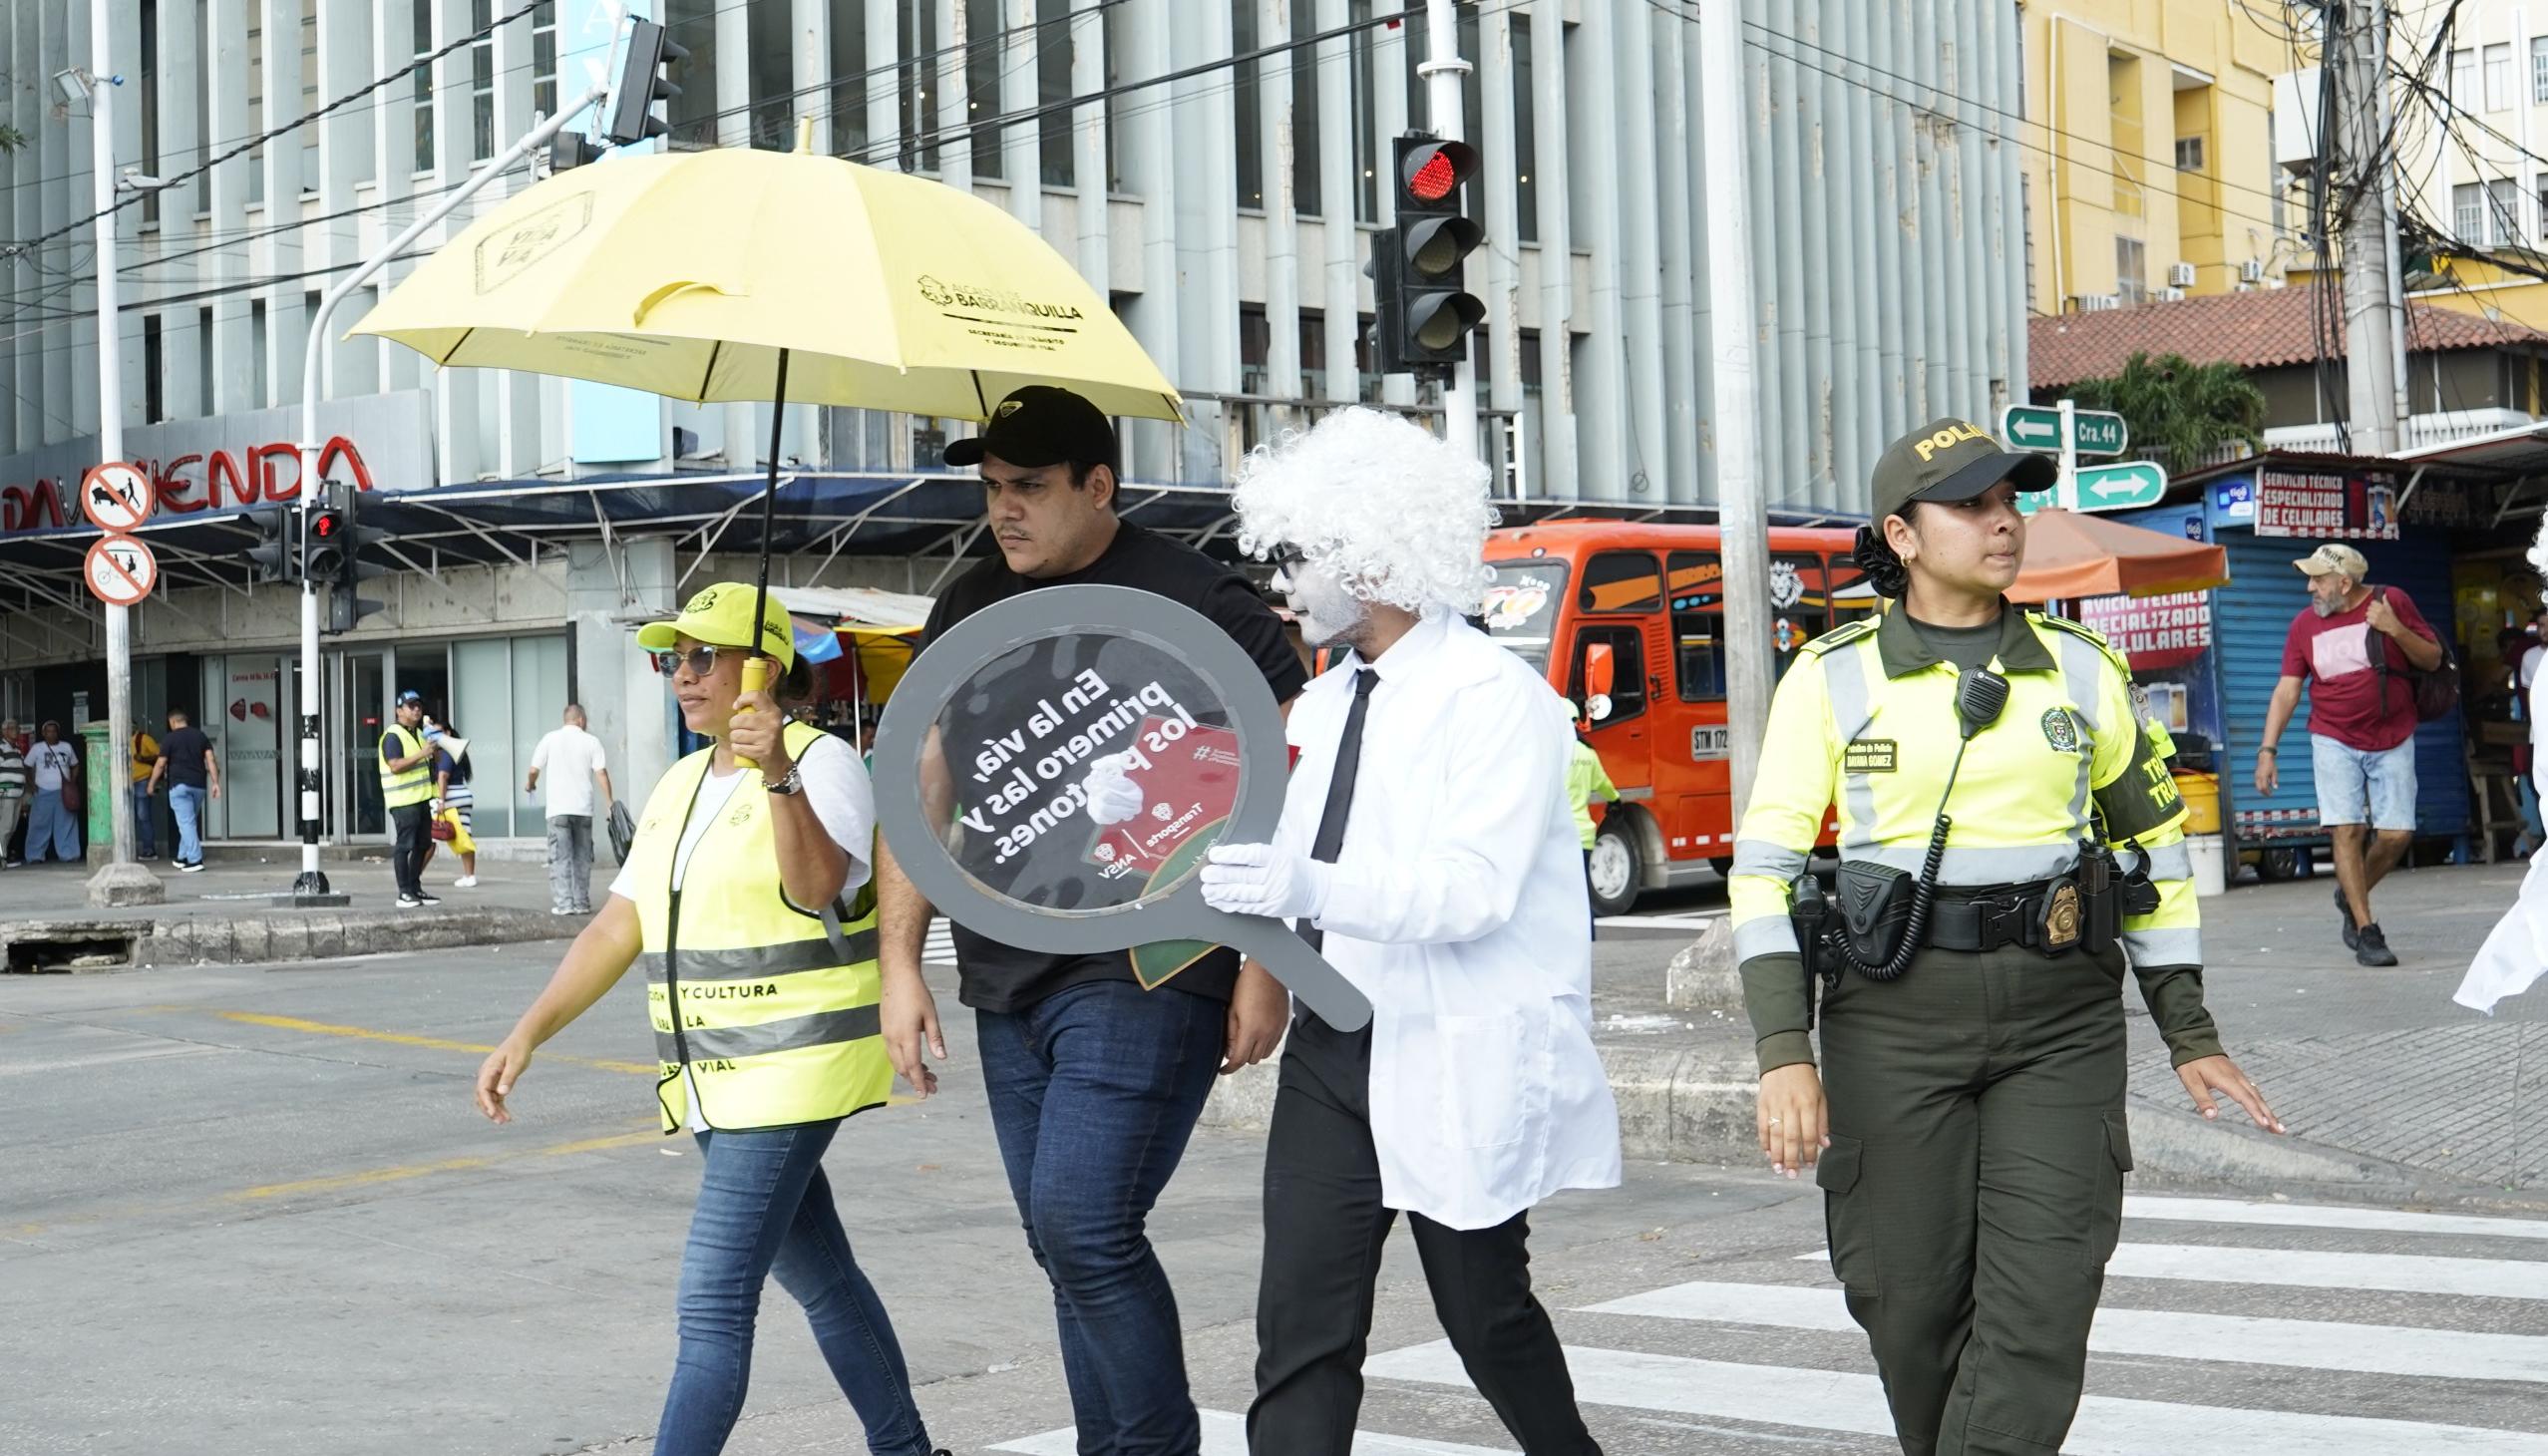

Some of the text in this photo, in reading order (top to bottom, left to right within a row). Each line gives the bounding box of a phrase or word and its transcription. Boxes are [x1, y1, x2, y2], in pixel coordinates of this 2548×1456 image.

[2078, 423, 2116, 444] Cra. 44
[3, 436, 373, 532] DAVIENDA
[2265, 472, 2307, 488] SERVICIO
[2264, 490, 2343, 508] ESPECIALIZADO
[2263, 508, 2278, 525] DE
[2282, 510, 2343, 528] CELULARES
[2108, 626, 2211, 653] ELULARES
[680, 986, 689, 998] Y
[693, 983, 778, 999] CULTURA
[685, 1015, 706, 1028] LA
[697, 1059, 736, 1074] VIAL
